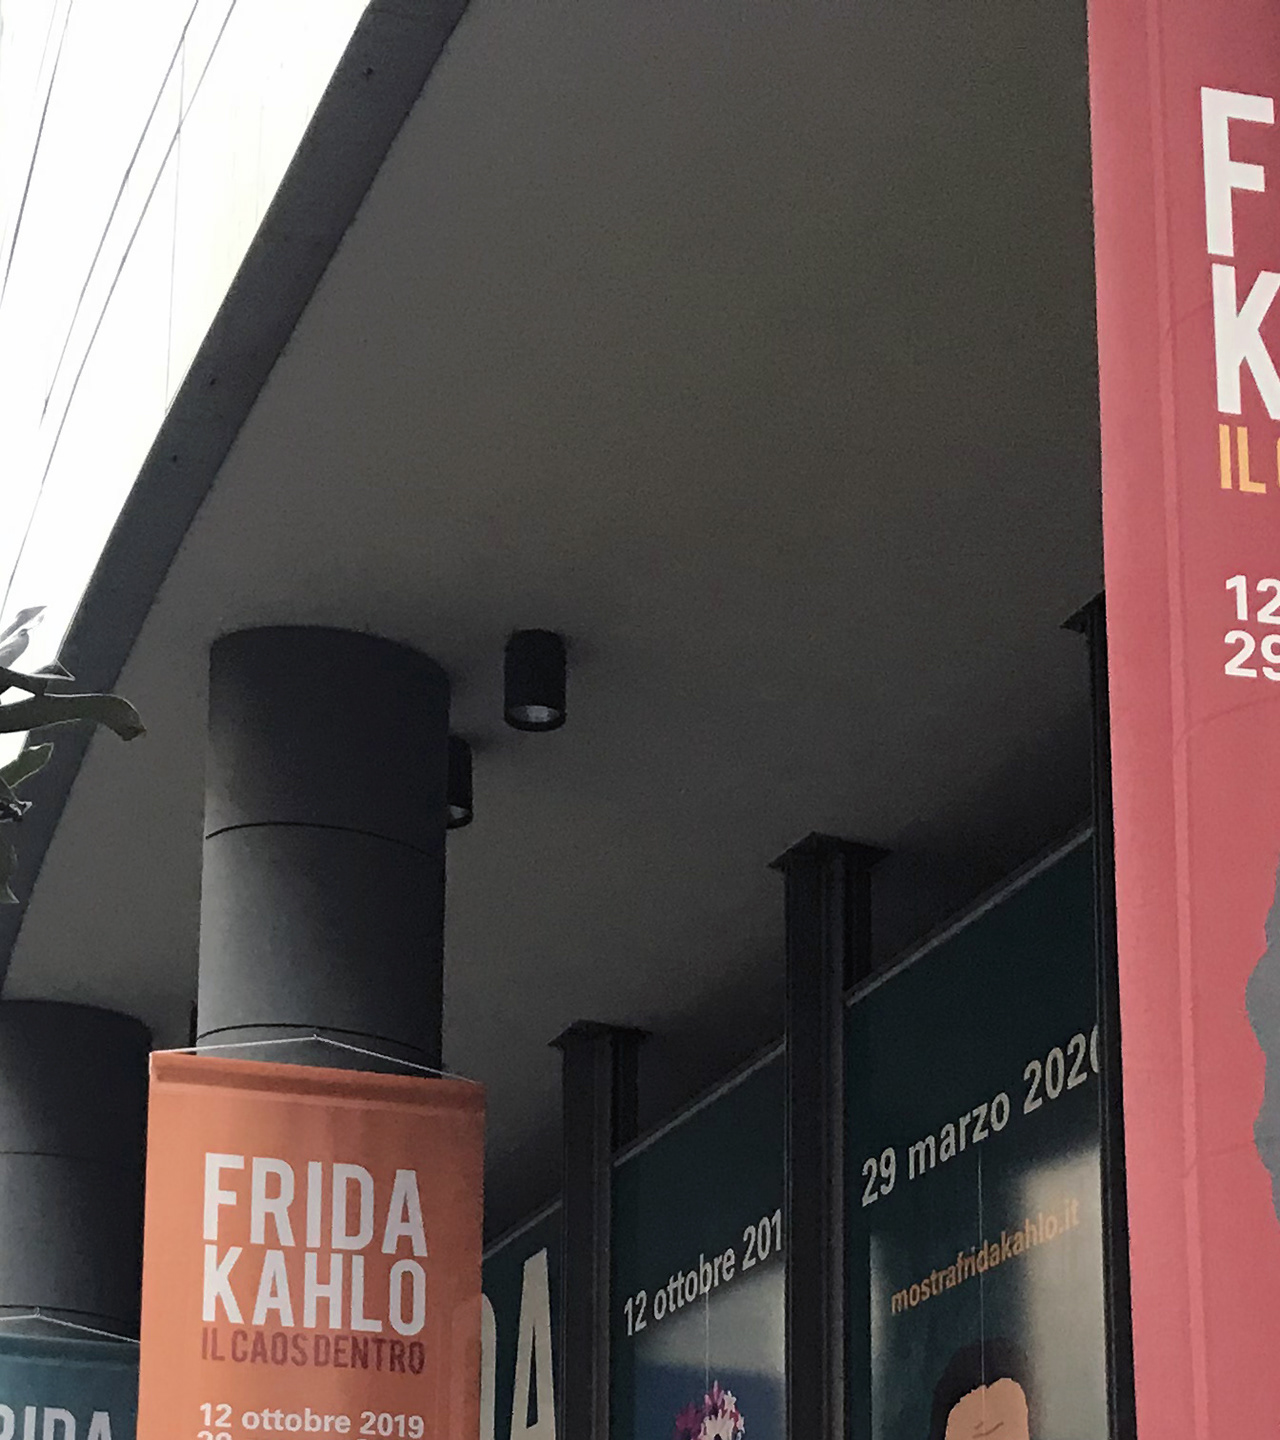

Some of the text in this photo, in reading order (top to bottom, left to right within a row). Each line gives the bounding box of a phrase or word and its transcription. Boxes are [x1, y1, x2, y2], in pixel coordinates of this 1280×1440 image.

[1218, 423, 1267, 495] IL
[861, 1147, 897, 1208] 29
[908, 1092, 1010, 1181] marzo
[203, 1152, 428, 1257] FRIDA
[202, 1244, 426, 1337] KAHLO
[623, 1208, 782, 1337] 12 ottobre 201
[891, 1198, 1080, 1317] mostrafridakahlo.it
[201, 1328, 425, 1376] IL CAOS DENTRO
[199, 1402, 424, 1440] 12 ottobre 2019
